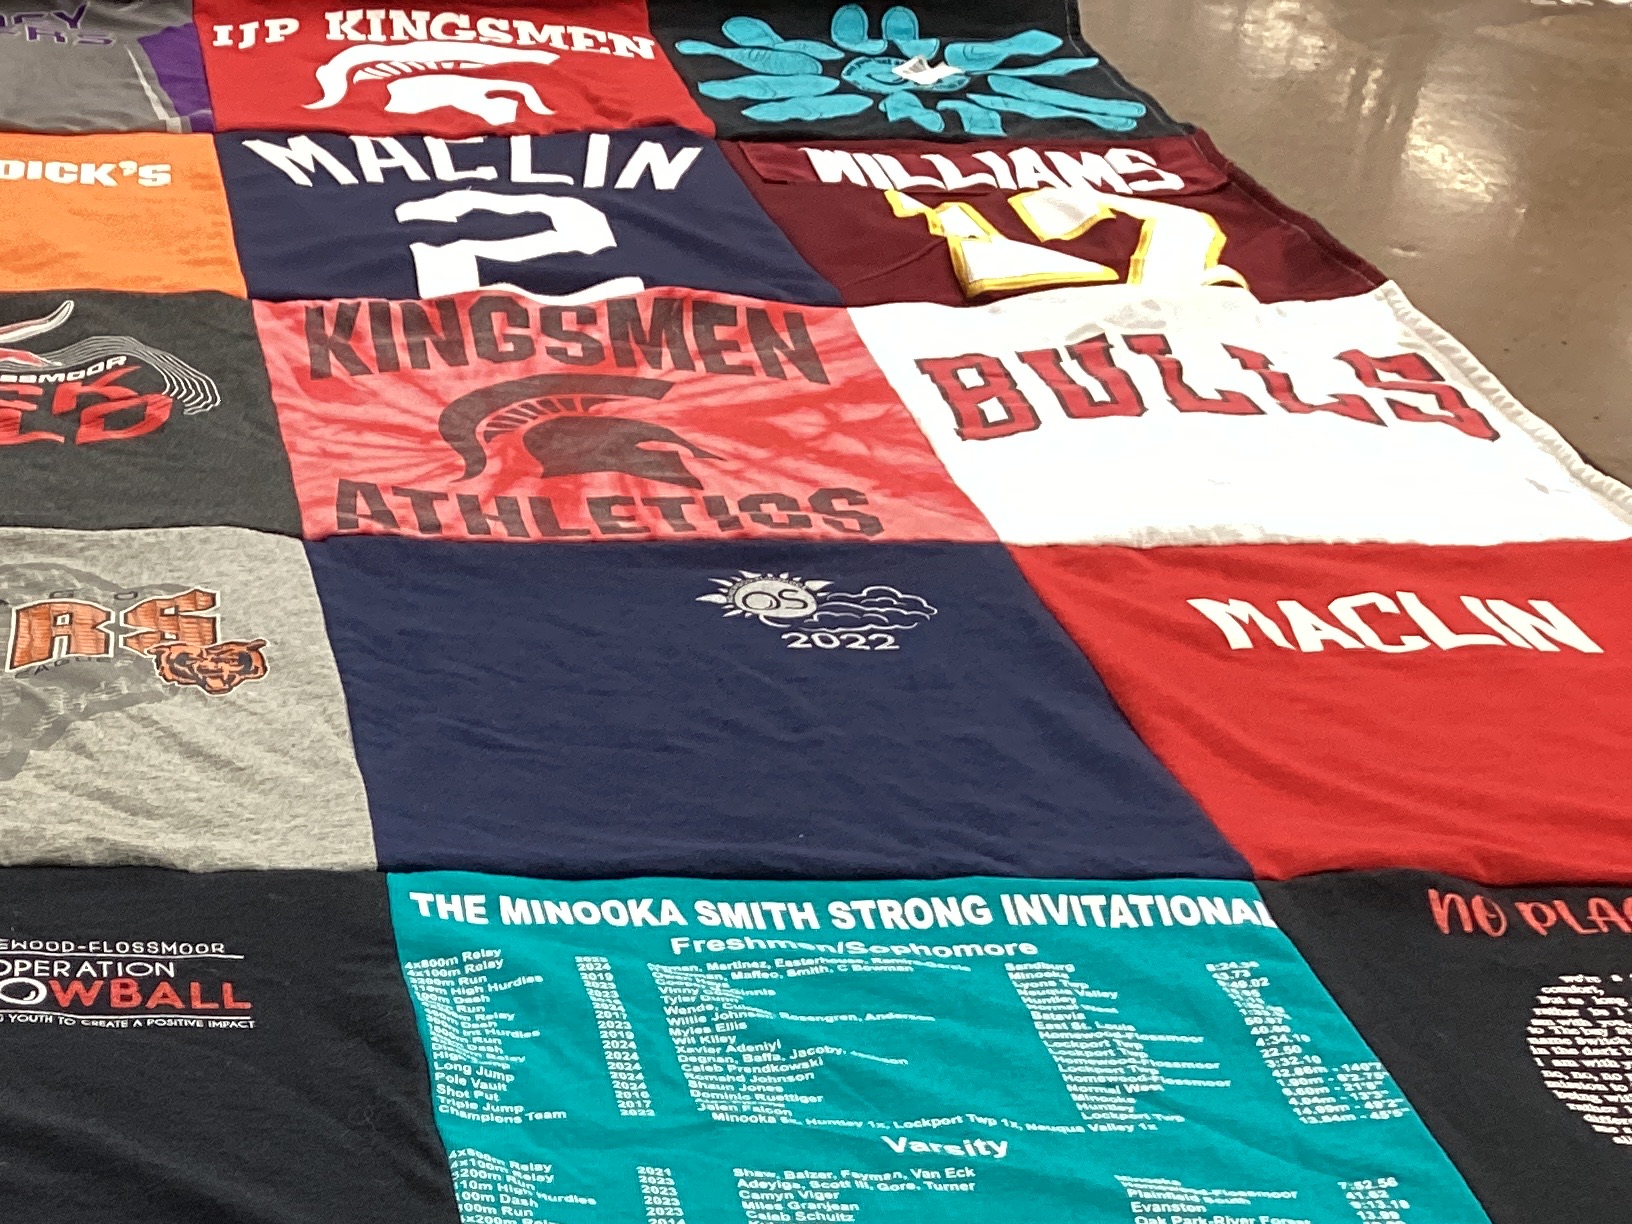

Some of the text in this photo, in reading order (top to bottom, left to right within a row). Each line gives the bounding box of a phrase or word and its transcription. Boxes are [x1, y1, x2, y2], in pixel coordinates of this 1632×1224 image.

[212, 9, 654, 59] IJP KINGSMEN
[242, 134, 703, 190] MACLIN
[799, 146, 1184, 195] WILLIAMS
[394, 188, 645, 306] 2
[302, 294, 831, 385] KINGSMEN
[913, 331, 1501, 443] BULLS
[335, 478, 885, 540] ATHLETICS
[1186, 590, 1605, 653] MACLIN
[781, 632, 900, 650] 2022
[408, 891, 489, 925] THE
[498, 894, 688, 927] MINOOKA
[696, 899, 821, 930] SMITH
[831, 893, 994, 930] STRONG
[1427, 888, 1508, 938] NO
[462, 948, 502, 962] Relay
[670, 934, 1038, 957] Freshman/Sophomore
[8, 1014, 54, 1024] YOUTH
[57, 1016, 76, 1026] TO
[80, 1018, 128, 1028] CREATE
[132, 1019, 143, 1028] A
[147, 1018, 204, 1028] POSITIVE
[207, 1019, 256, 1029] IMPACT
[602, 1040, 637, 1050] 2024
[604, 1051, 639, 1061] 2024
[433, 1061, 515, 1083] Long Jump
[434, 1072, 508, 1092] Pole Vault
[436, 1083, 500, 1102] Shot Put
[438, 1104, 567, 1124] Champions Team
[482, 1103, 524, 1113] Jump
[880, 1135, 1008, 1158] Varsity
[509, 1160, 552, 1173] Relay
[636, 1166, 671, 1177] 2021
[910, 1167, 976, 1179] Van Eck
[923, 1180, 976, 1192] Turner
[1131, 1201, 1207, 1213] Evanston
